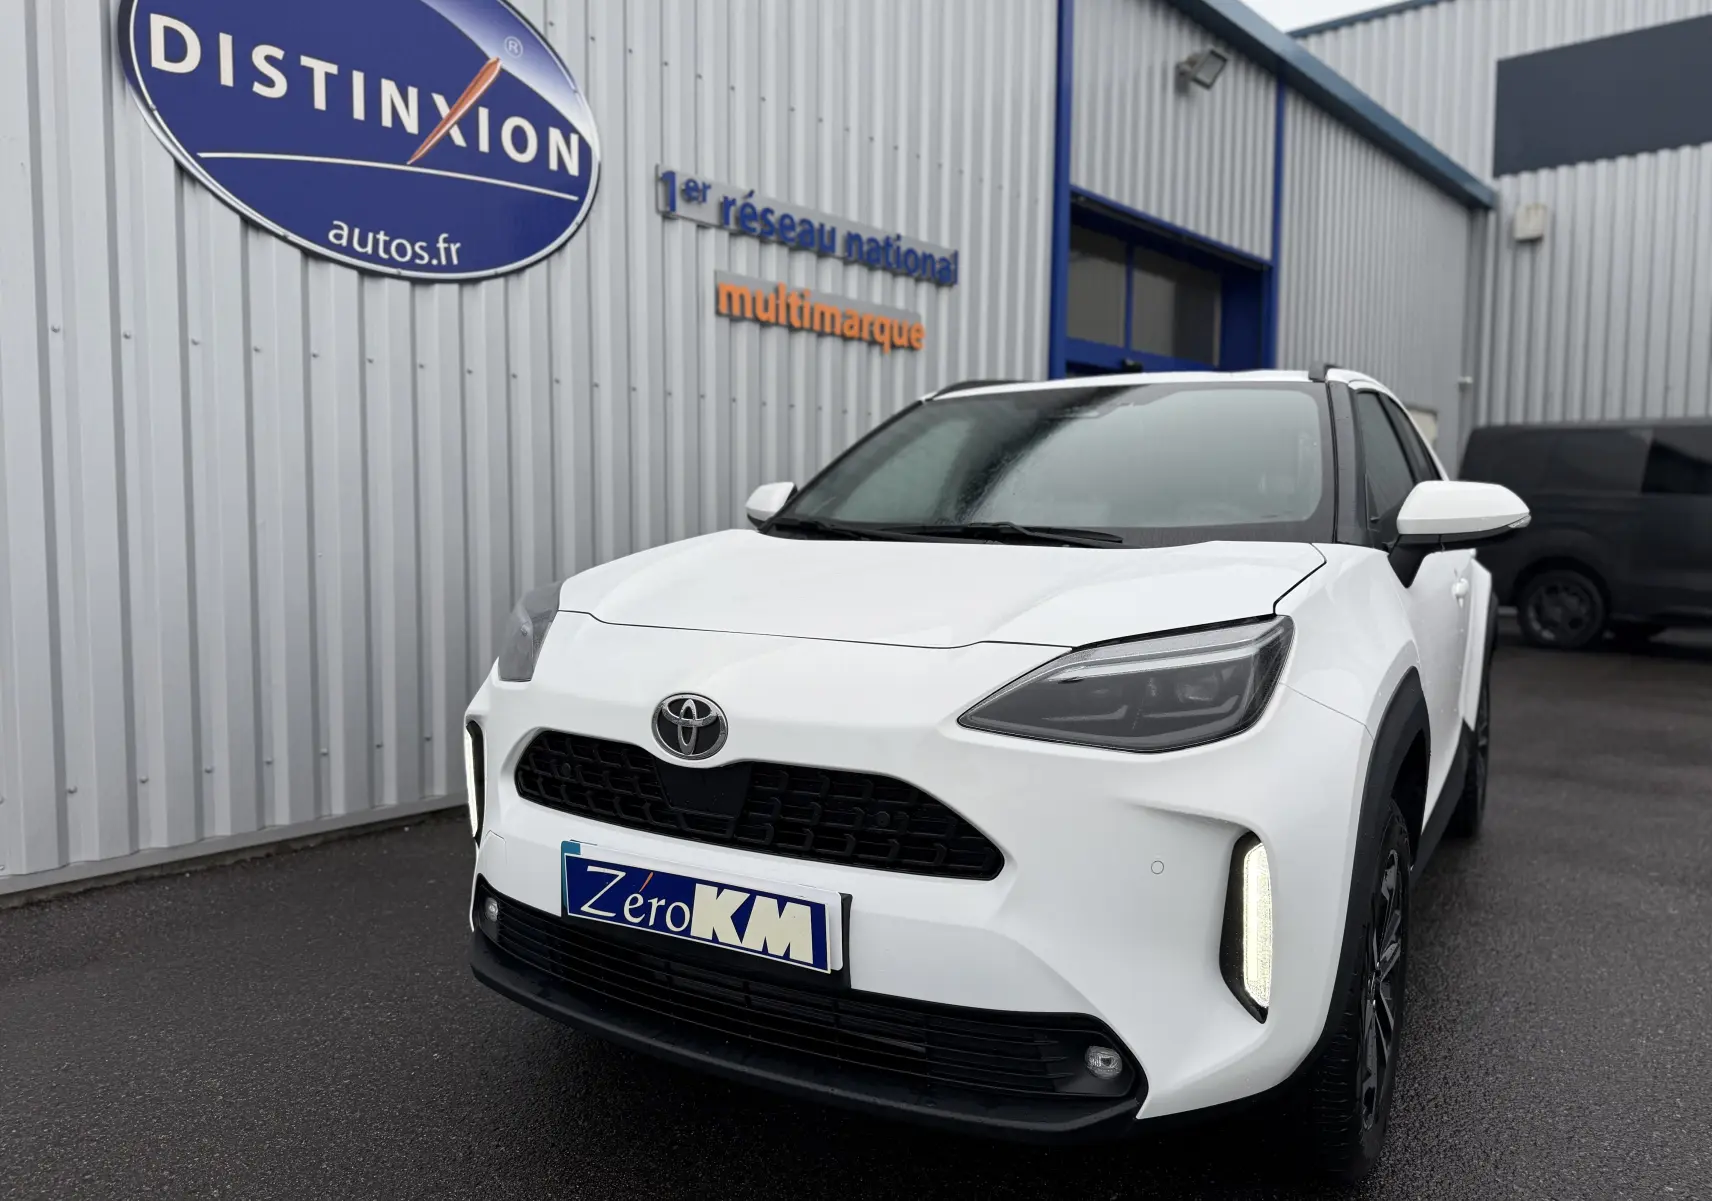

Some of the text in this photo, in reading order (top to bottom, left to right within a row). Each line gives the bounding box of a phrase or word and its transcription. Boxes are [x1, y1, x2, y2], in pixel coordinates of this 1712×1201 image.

[149, 13, 580, 176] DISTINXION
[328, 220, 461, 266] autos.fr
[661, 170, 958, 285] 1er réseau national
[717, 282, 925, 353] multimarque
